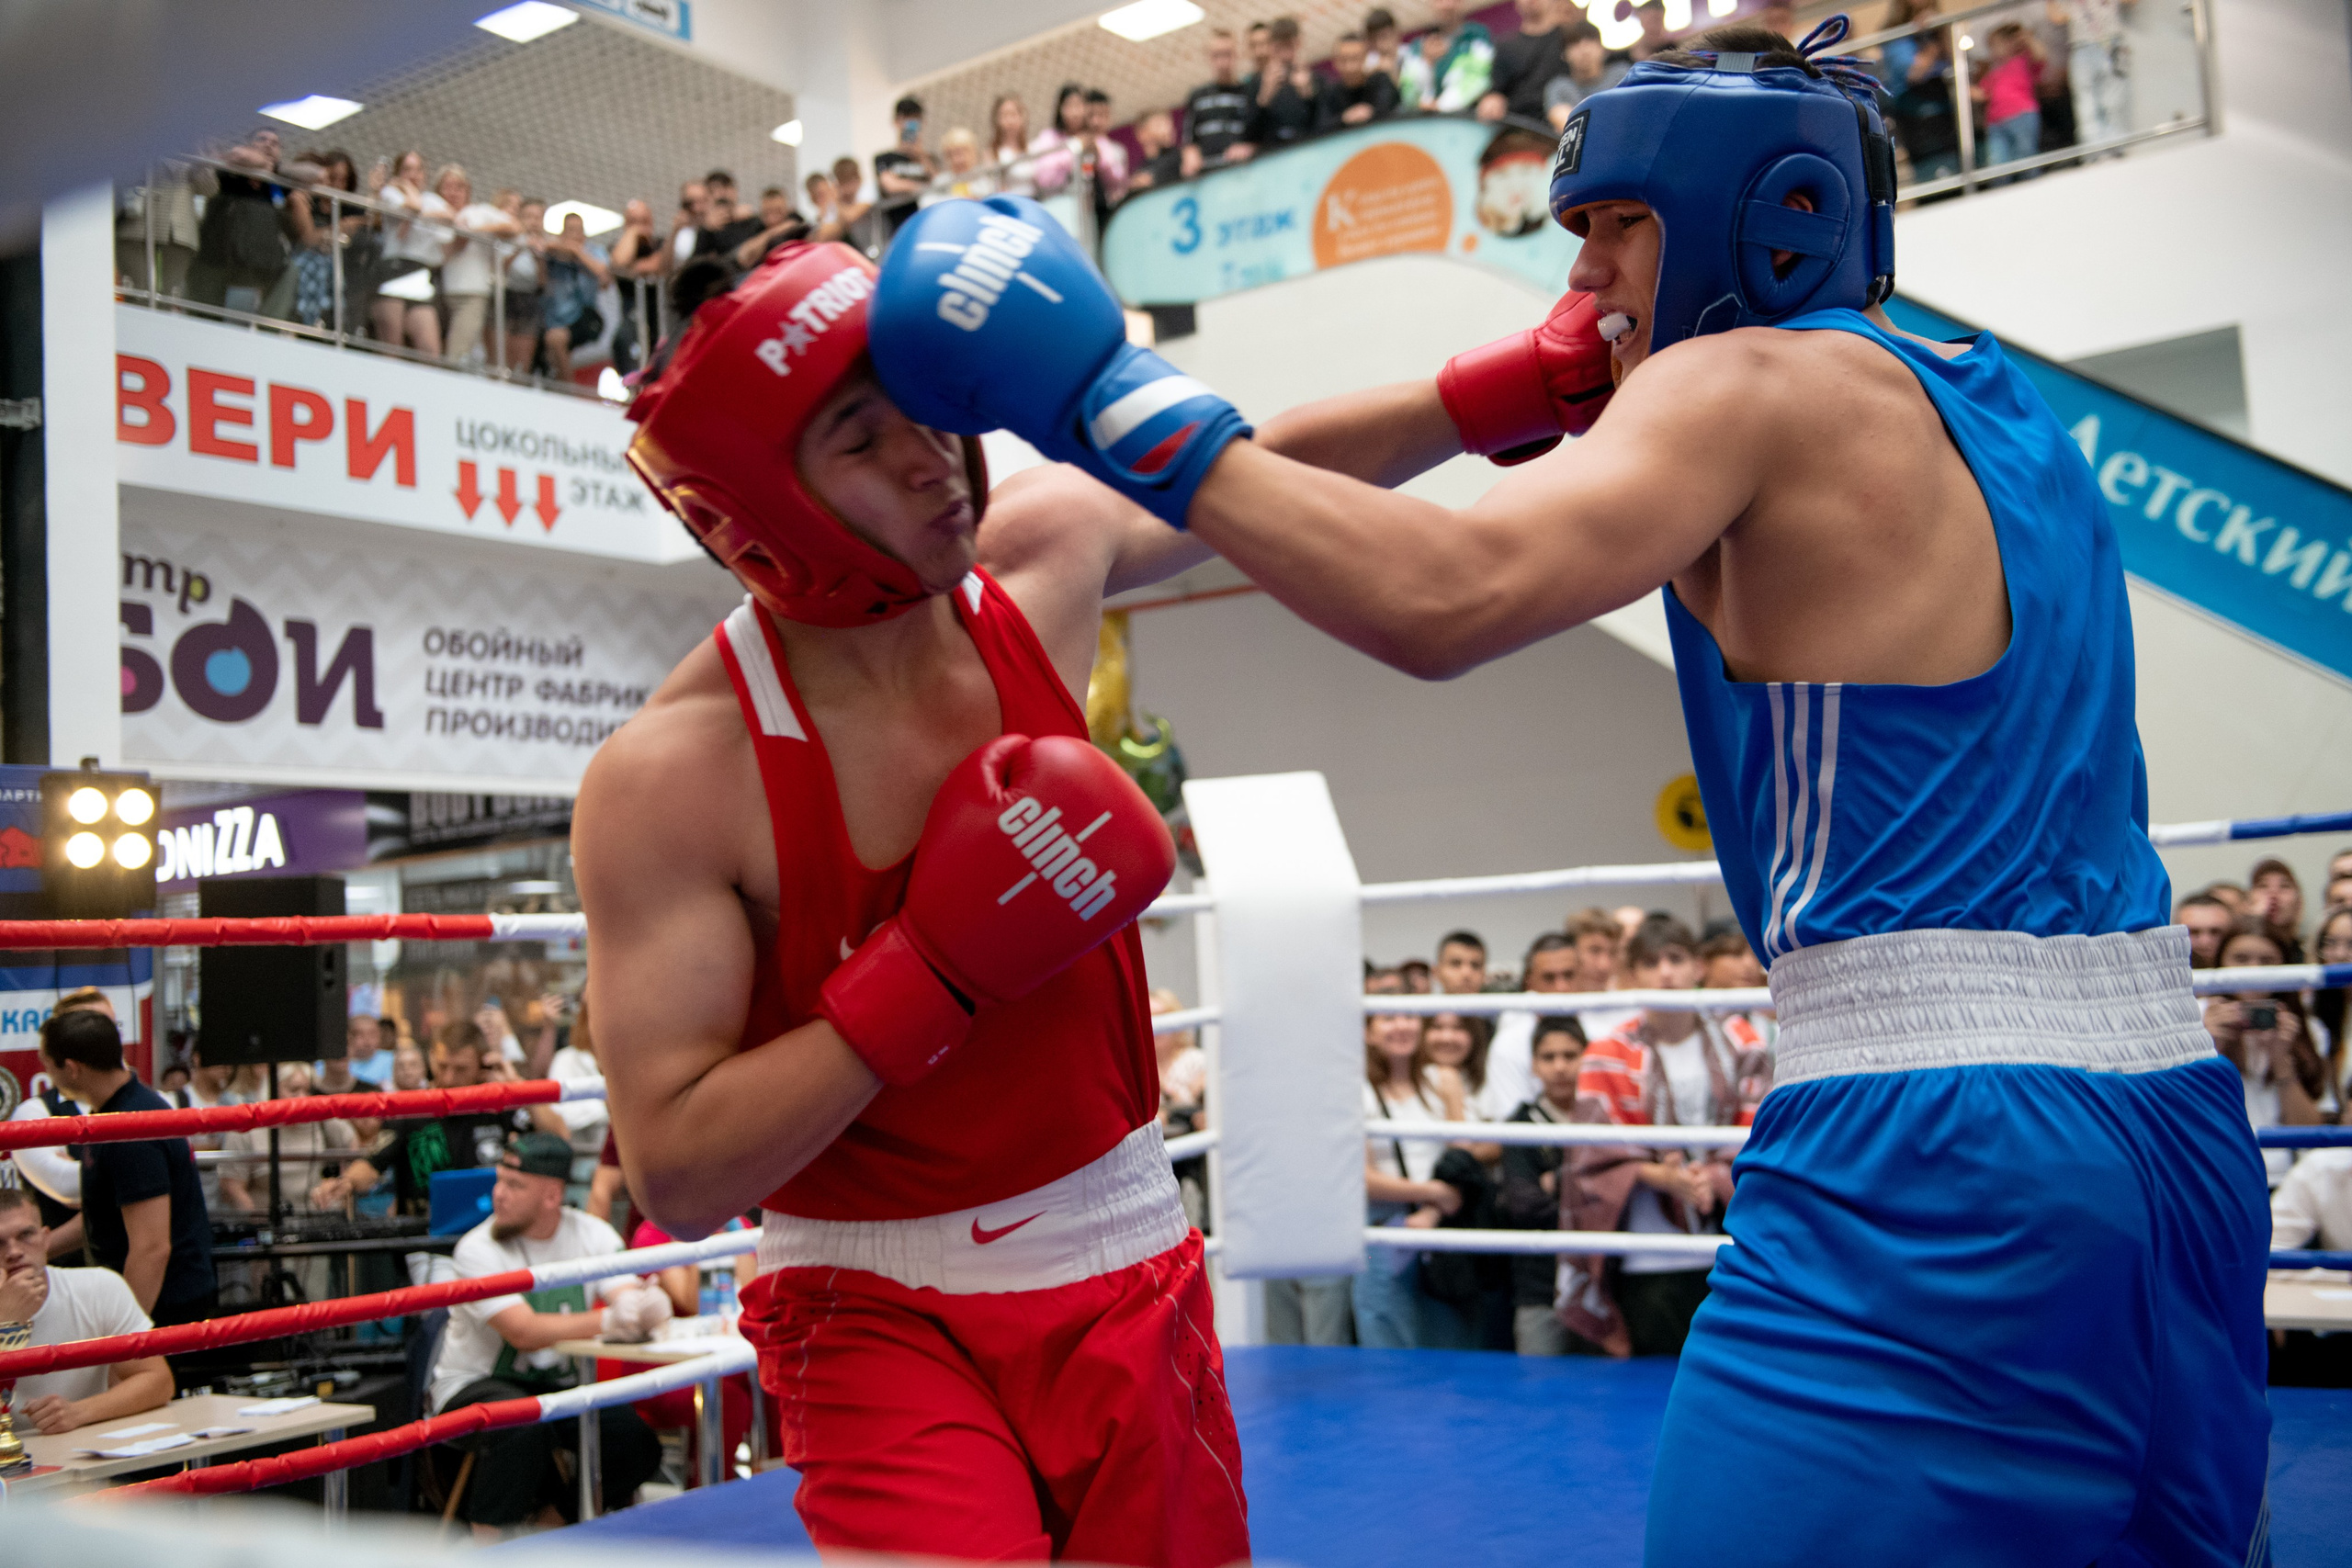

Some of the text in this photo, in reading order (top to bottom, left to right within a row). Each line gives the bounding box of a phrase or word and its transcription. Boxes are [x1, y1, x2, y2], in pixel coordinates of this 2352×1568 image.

[1171, 196, 1203, 255] 3
[937, 215, 1045, 332] clinch
[117, 354, 417, 488] ВЕРИ
[456, 416, 629, 471] ЦОКОЛЬНЫ
[571, 476, 647, 511] ЭТАЖ
[424, 626, 584, 668] ОБОЙНЫЙ
[426, 667, 524, 699] ЦЕНТР
[998, 795, 1117, 921] clinch
